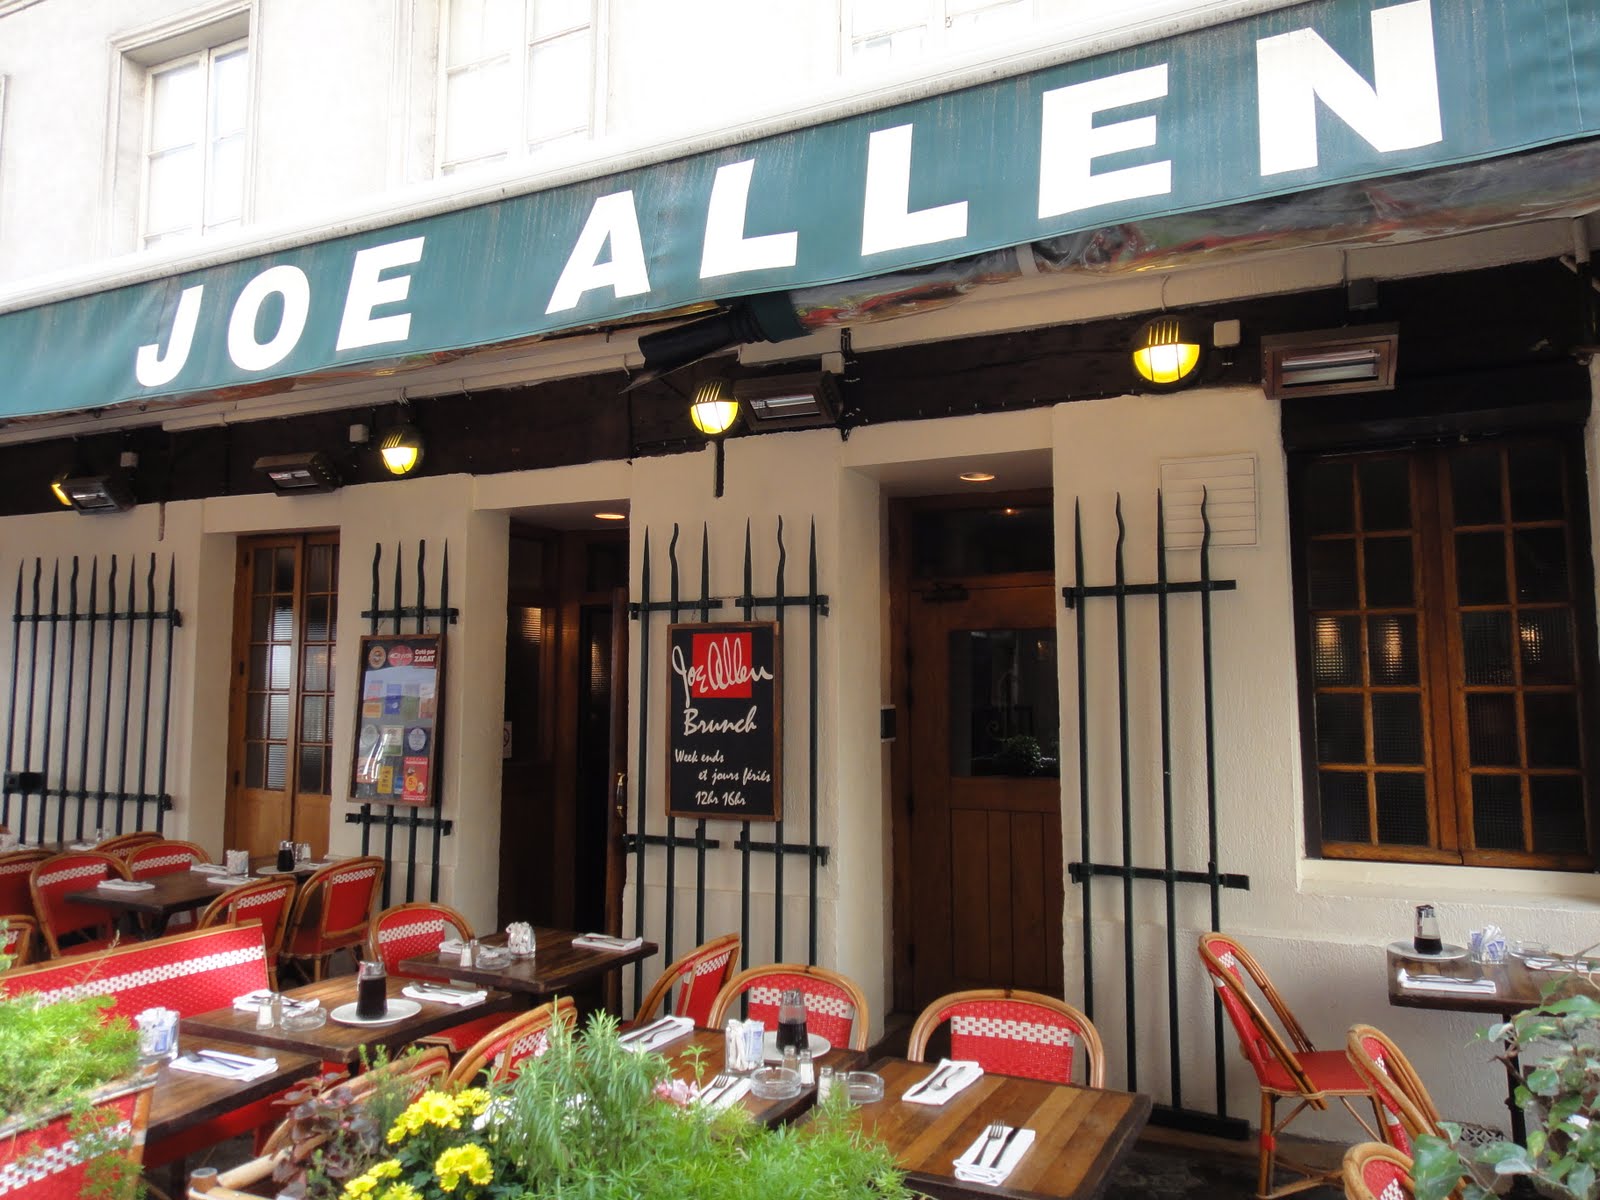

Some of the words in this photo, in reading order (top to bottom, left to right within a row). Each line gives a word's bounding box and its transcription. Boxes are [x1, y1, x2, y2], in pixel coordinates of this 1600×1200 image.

[136, 236, 425, 388] JOE
[545, 0, 1443, 314] ALLEN
[683, 705, 757, 736] Brunch
[674, 748, 699, 763] Week
[700, 749, 724, 763] ends
[698, 768, 708, 781] et
[711, 768, 740, 786] jours
